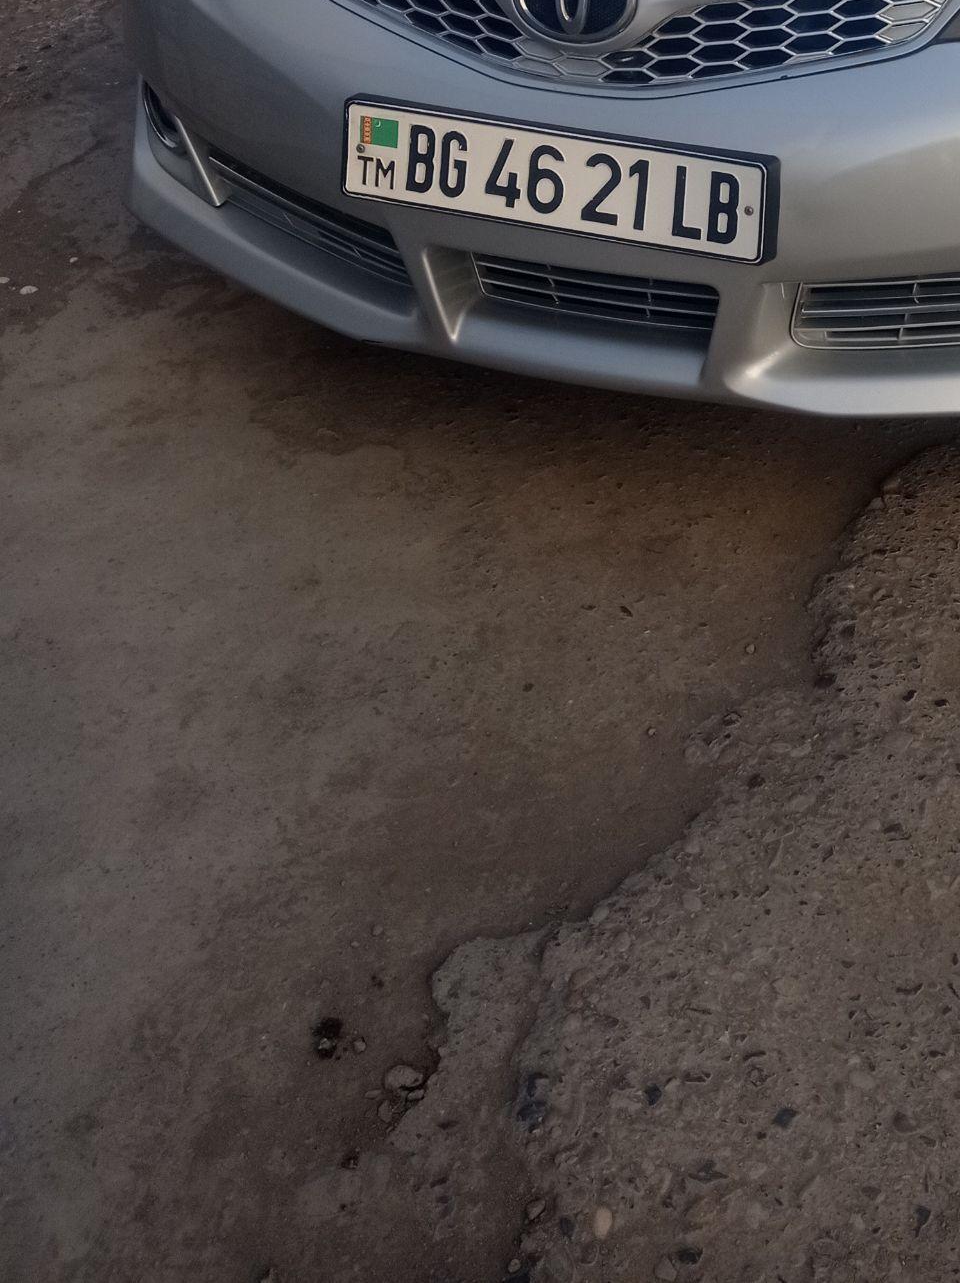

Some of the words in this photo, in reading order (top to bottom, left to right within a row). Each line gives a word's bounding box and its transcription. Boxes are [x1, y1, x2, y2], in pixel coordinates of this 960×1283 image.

[357, 155, 395, 190] TM
[405, 124, 468, 198] BG
[484, 138, 564, 214] 46
[580, 154, 650, 231] 21
[671, 165, 740, 244] LB
